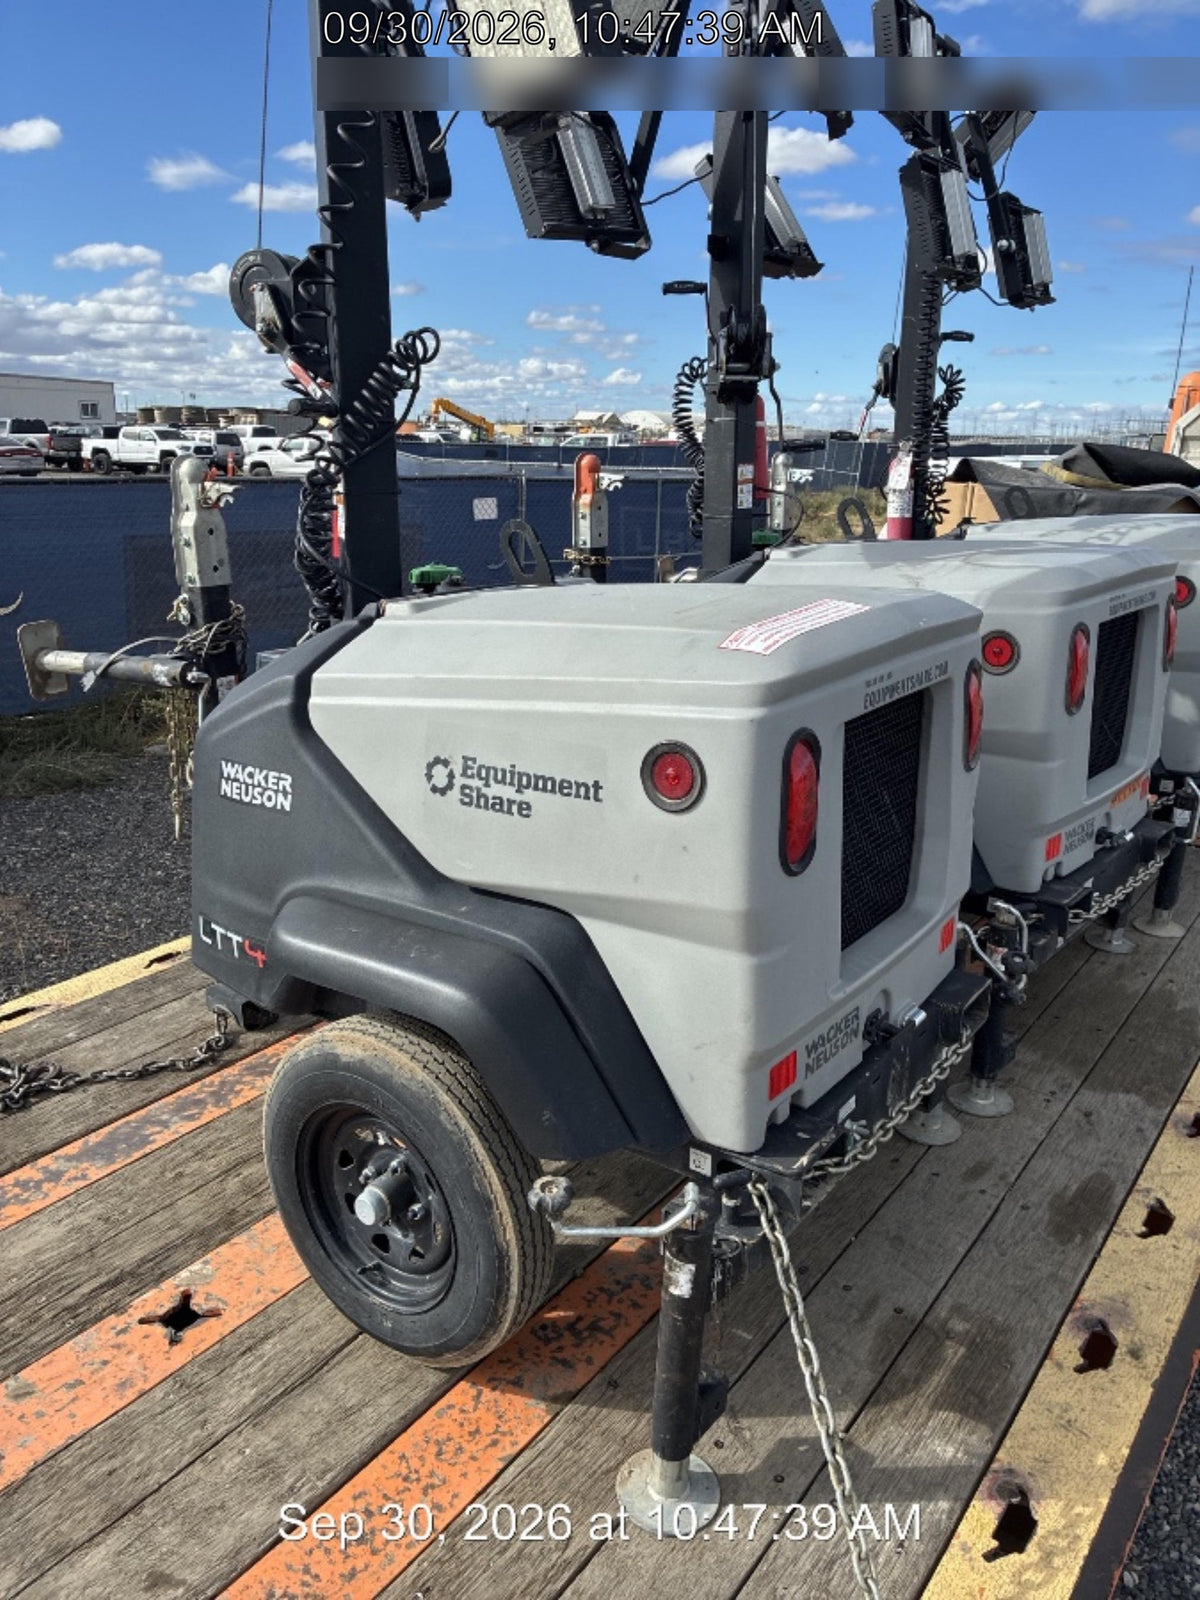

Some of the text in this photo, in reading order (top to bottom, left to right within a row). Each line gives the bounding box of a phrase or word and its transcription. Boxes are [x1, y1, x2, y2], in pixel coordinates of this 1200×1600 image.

[220, 760, 292, 794] WACKER
[220, 778, 292, 812] NEUSON
[458, 783, 533, 819] Share
[459, 754, 604, 802] Equipment
[198, 915, 268, 968] LTT4
[804, 1005, 860, 1059] WACKER
[804, 1021, 860, 1080] NEUSON
